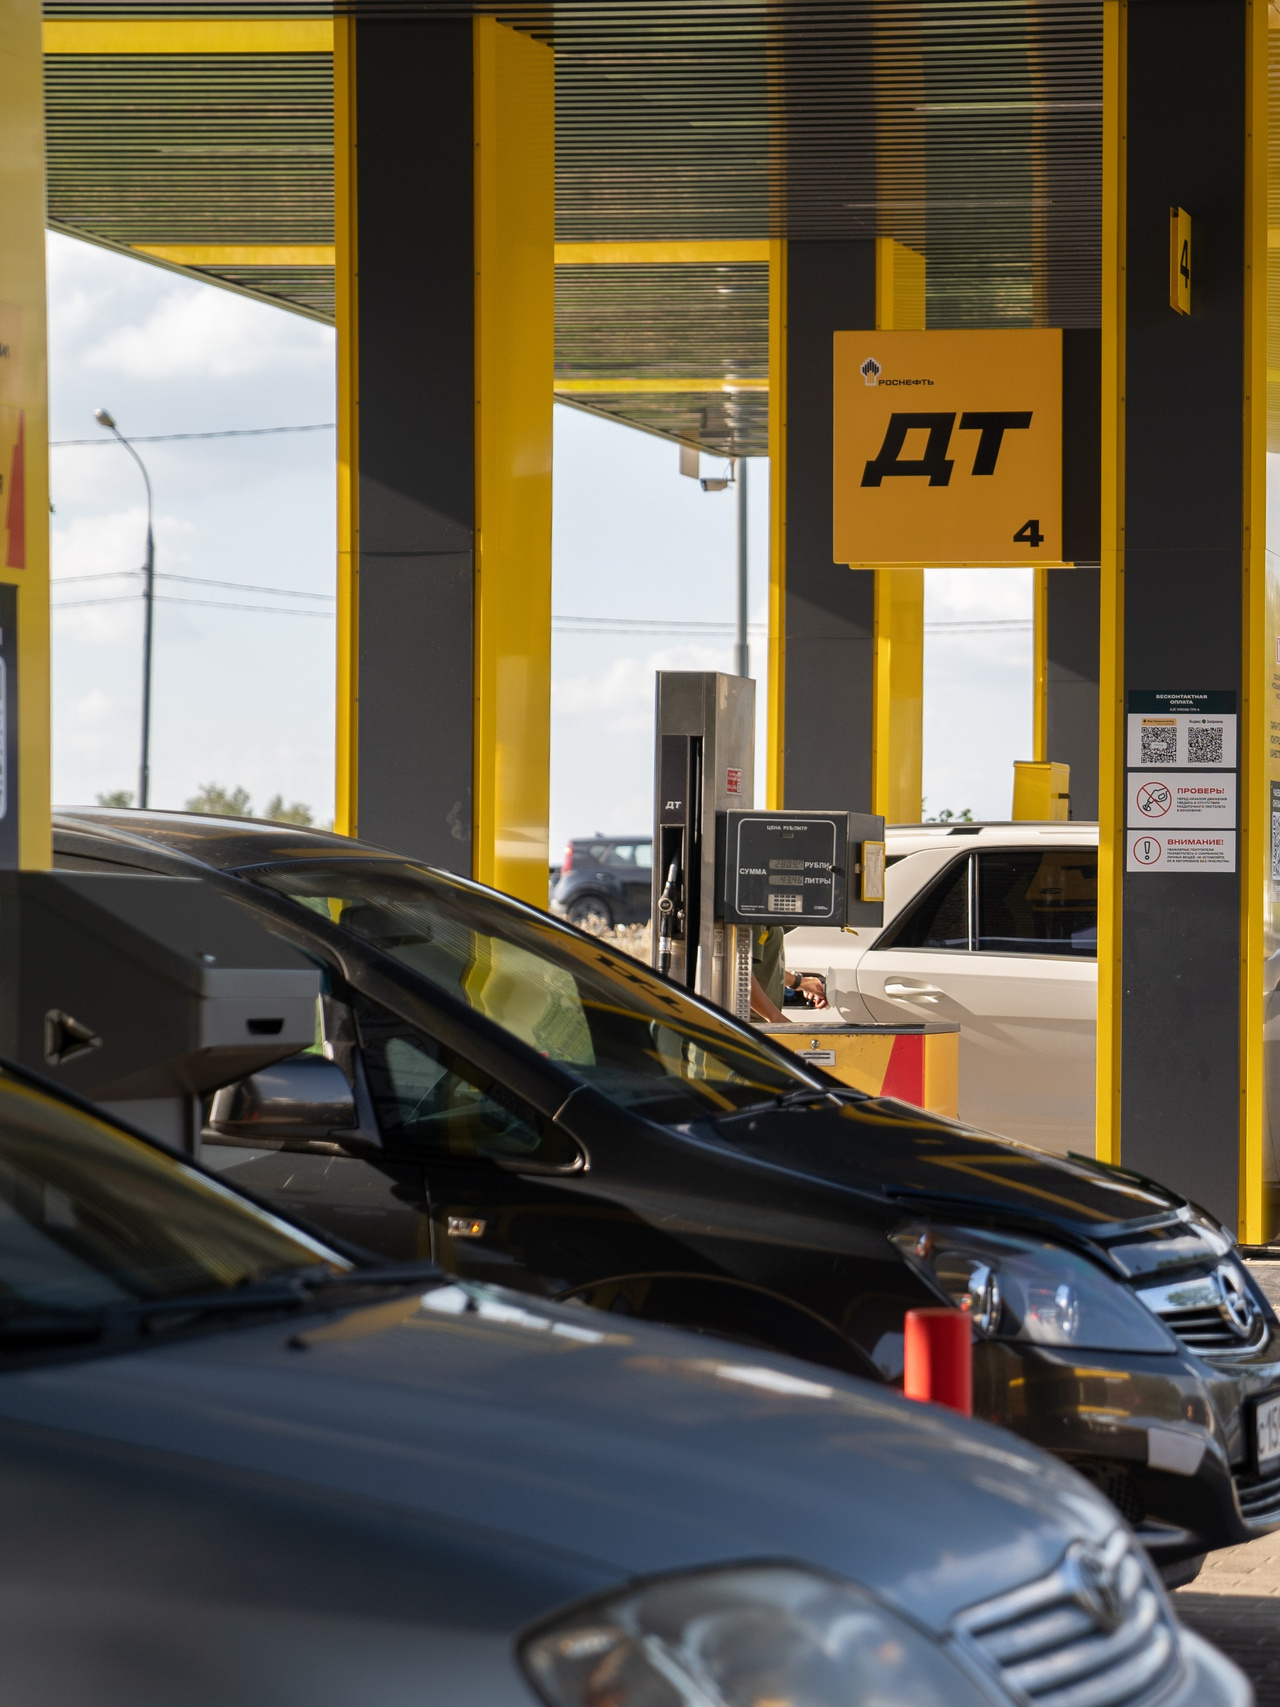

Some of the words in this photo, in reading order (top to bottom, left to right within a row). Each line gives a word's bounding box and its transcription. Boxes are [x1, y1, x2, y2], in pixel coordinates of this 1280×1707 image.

[1180, 239, 1190, 289] 4
[878, 378, 935, 387] РОСНЕФТЬ
[860, 411, 1033, 487] ДТ
[1013, 519, 1045, 548] 4
[665, 801, 682, 810] ДТ
